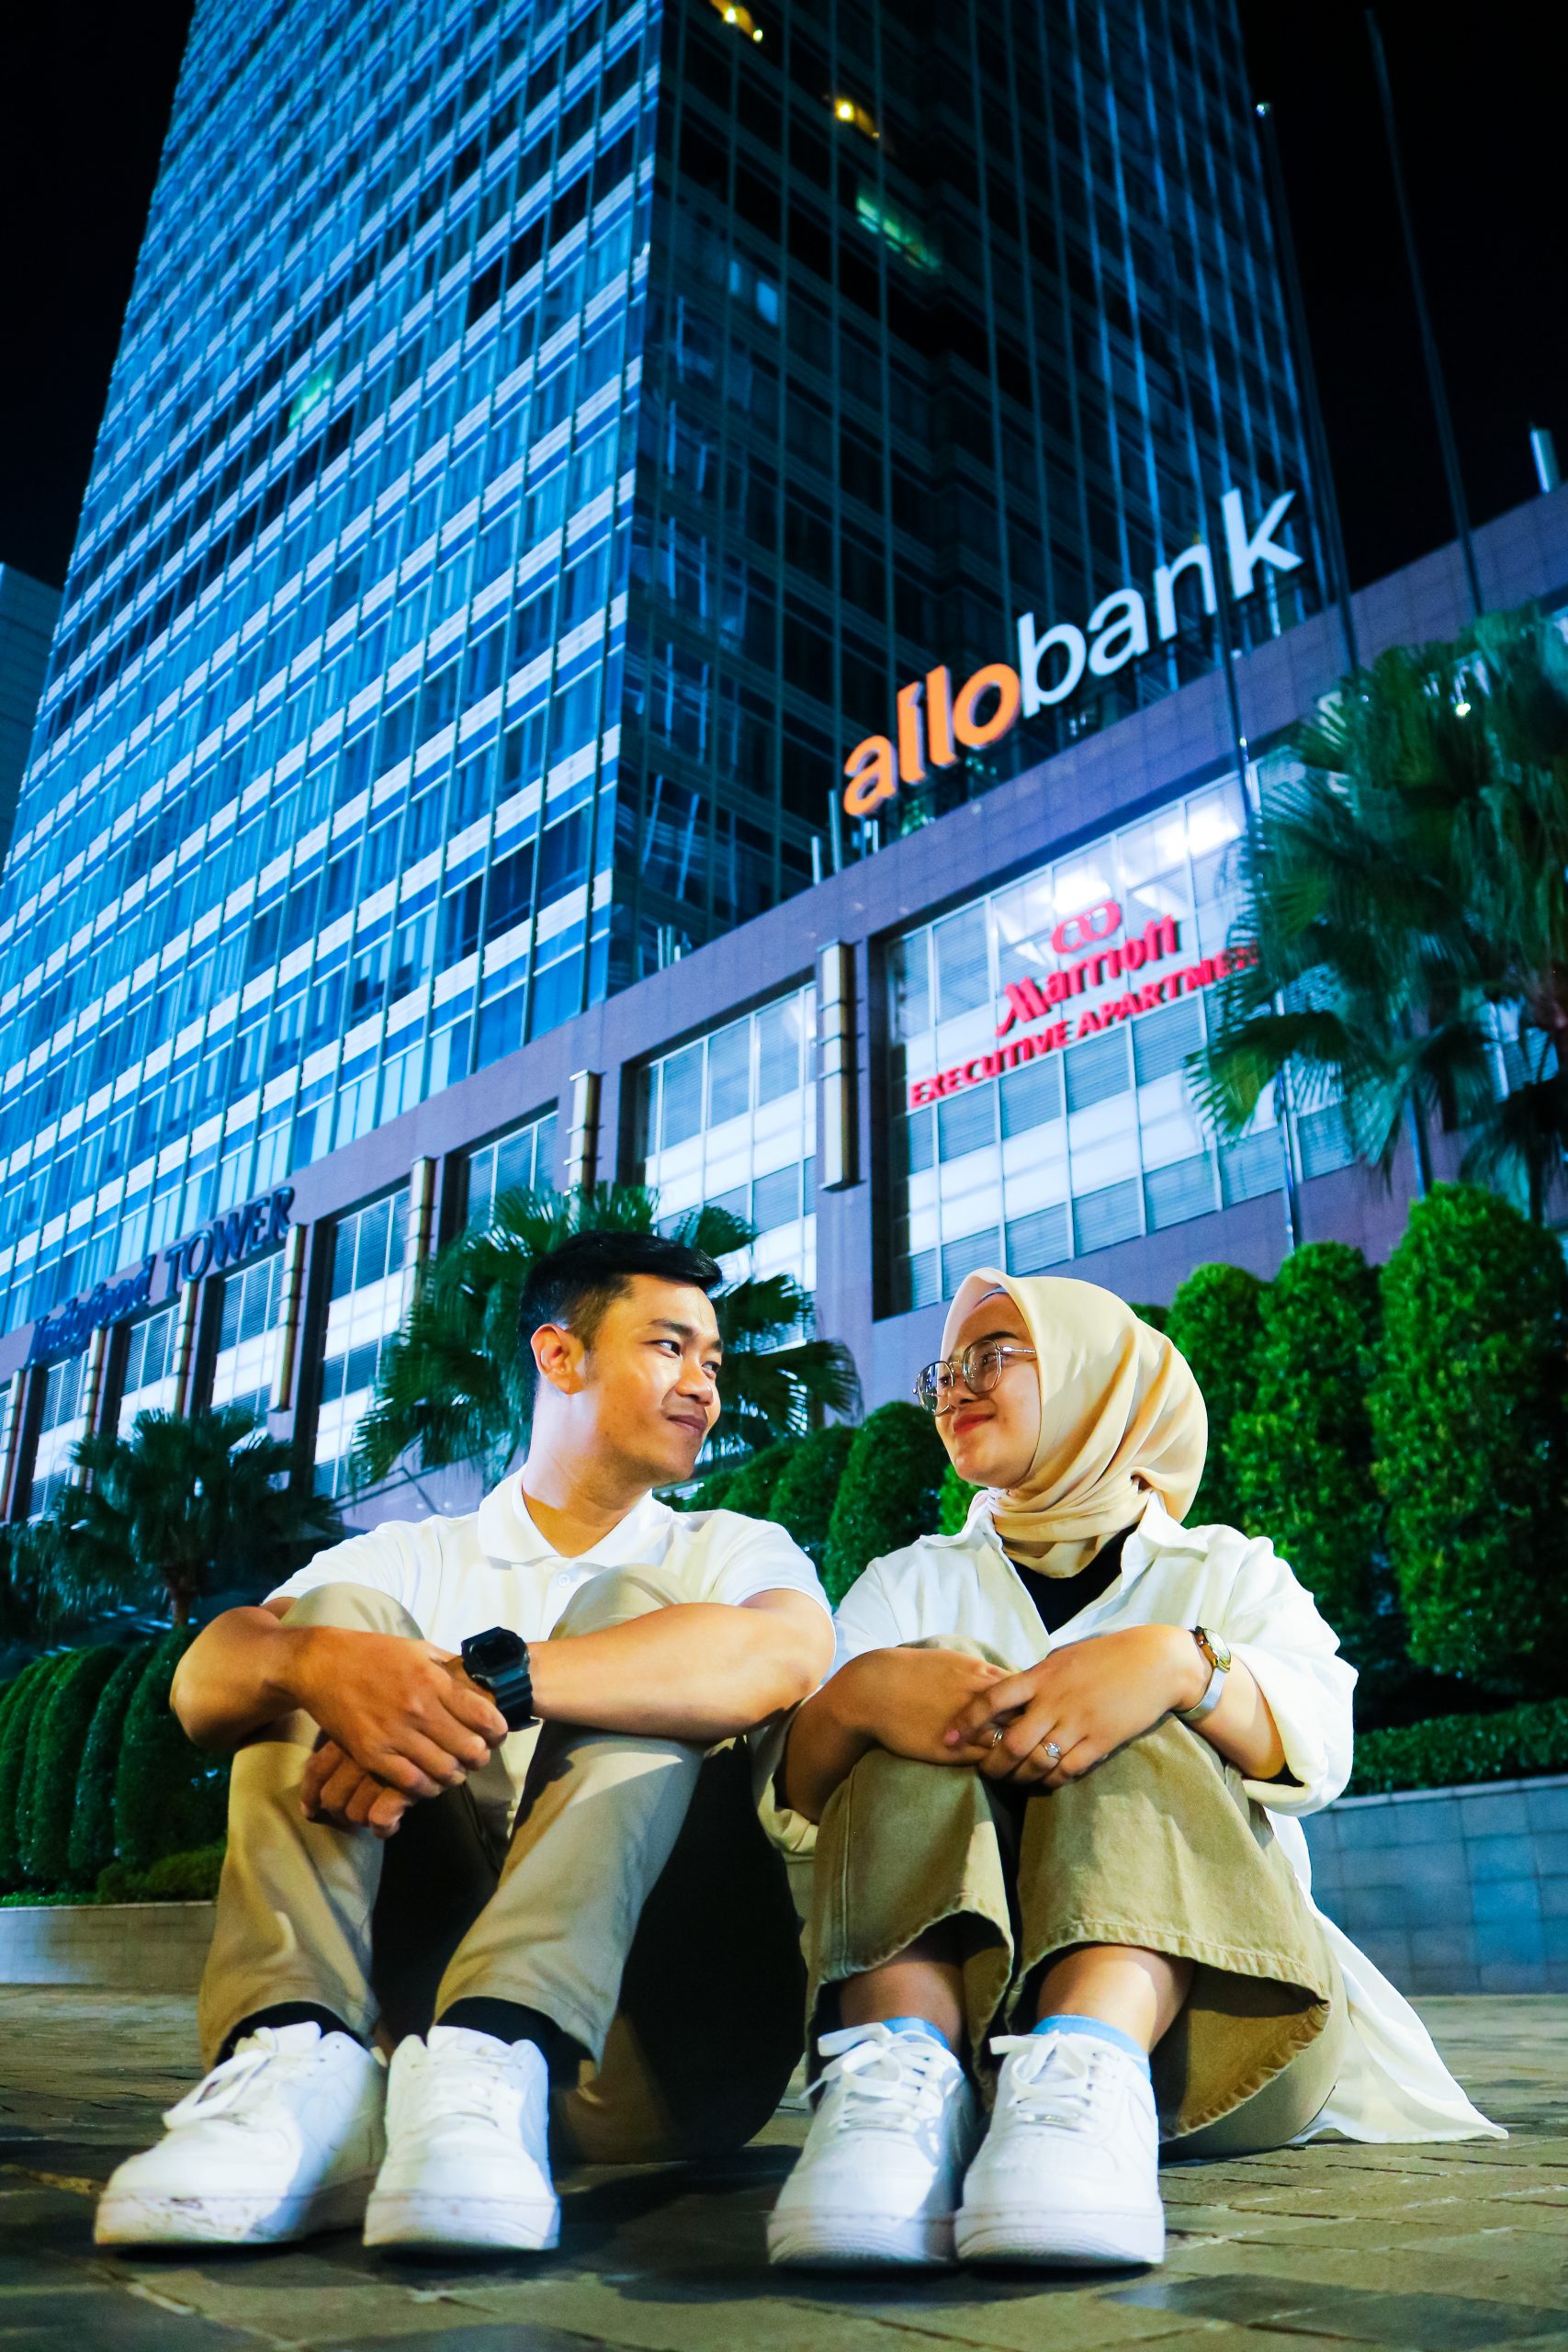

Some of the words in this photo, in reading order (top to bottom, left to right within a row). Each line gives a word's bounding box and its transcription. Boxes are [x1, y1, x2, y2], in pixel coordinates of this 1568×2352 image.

[843, 489, 1304, 816] allobank
[996, 913, 1179, 1036] Marriott
[910, 1020, 1070, 1109] EXECUTIVE
[164, 1185, 295, 1298] TOWER
